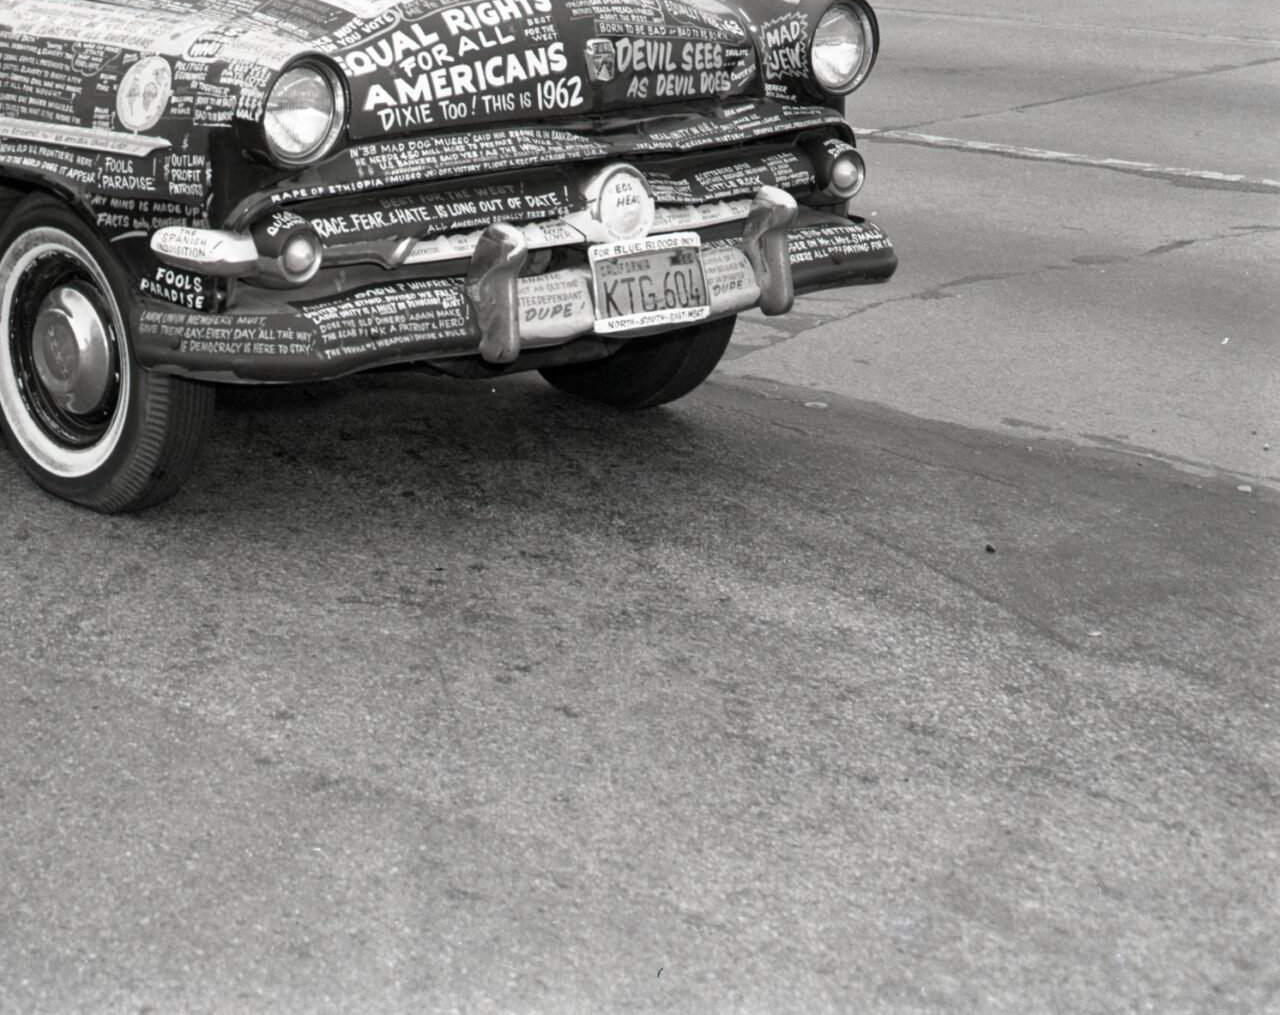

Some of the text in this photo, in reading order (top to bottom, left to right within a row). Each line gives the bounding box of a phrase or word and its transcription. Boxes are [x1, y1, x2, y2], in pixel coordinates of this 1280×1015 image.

[766, 22, 800, 47] MAD
[399, 26, 515, 77] FOR ALL
[616, 38, 677, 72] DEVIL
[770, 42, 801, 70] JEW
[363, 42, 567, 111] AMERICANS
[627, 71, 731, 98] AS DEVIL DOES
[377, 104, 433, 131] DIXIE
[481, 93, 515, 114] THIS
[520, 92, 531, 107] IS
[537, 76, 584, 110] 1962
[105, 157, 133, 174] FOOLS
[171, 155, 206, 166] OUTLAW
[103, 175, 155, 191] PARADISE
[171, 169, 200, 182] PROFIT
[169, 183, 203, 196] PATRIOTS
[271, 179, 384, 203] RAPE OF ETHIOPIA
[447, 201, 477, 215] LONG
[479, 199, 504, 212] OUT
[507, 198, 522, 208] OF
[96, 213, 129, 228] FACTS
[162, 233, 207, 246] SPANISH
[156, 244, 206, 257] INQUISITION
[601, 259, 650, 277] CALIFORNIA
[156, 267, 203, 292] FOOLS
[712, 280, 743, 296] DUPE
[140, 279, 204, 309] PARADISE
[190, 341, 241, 353] DEMOCRACY
